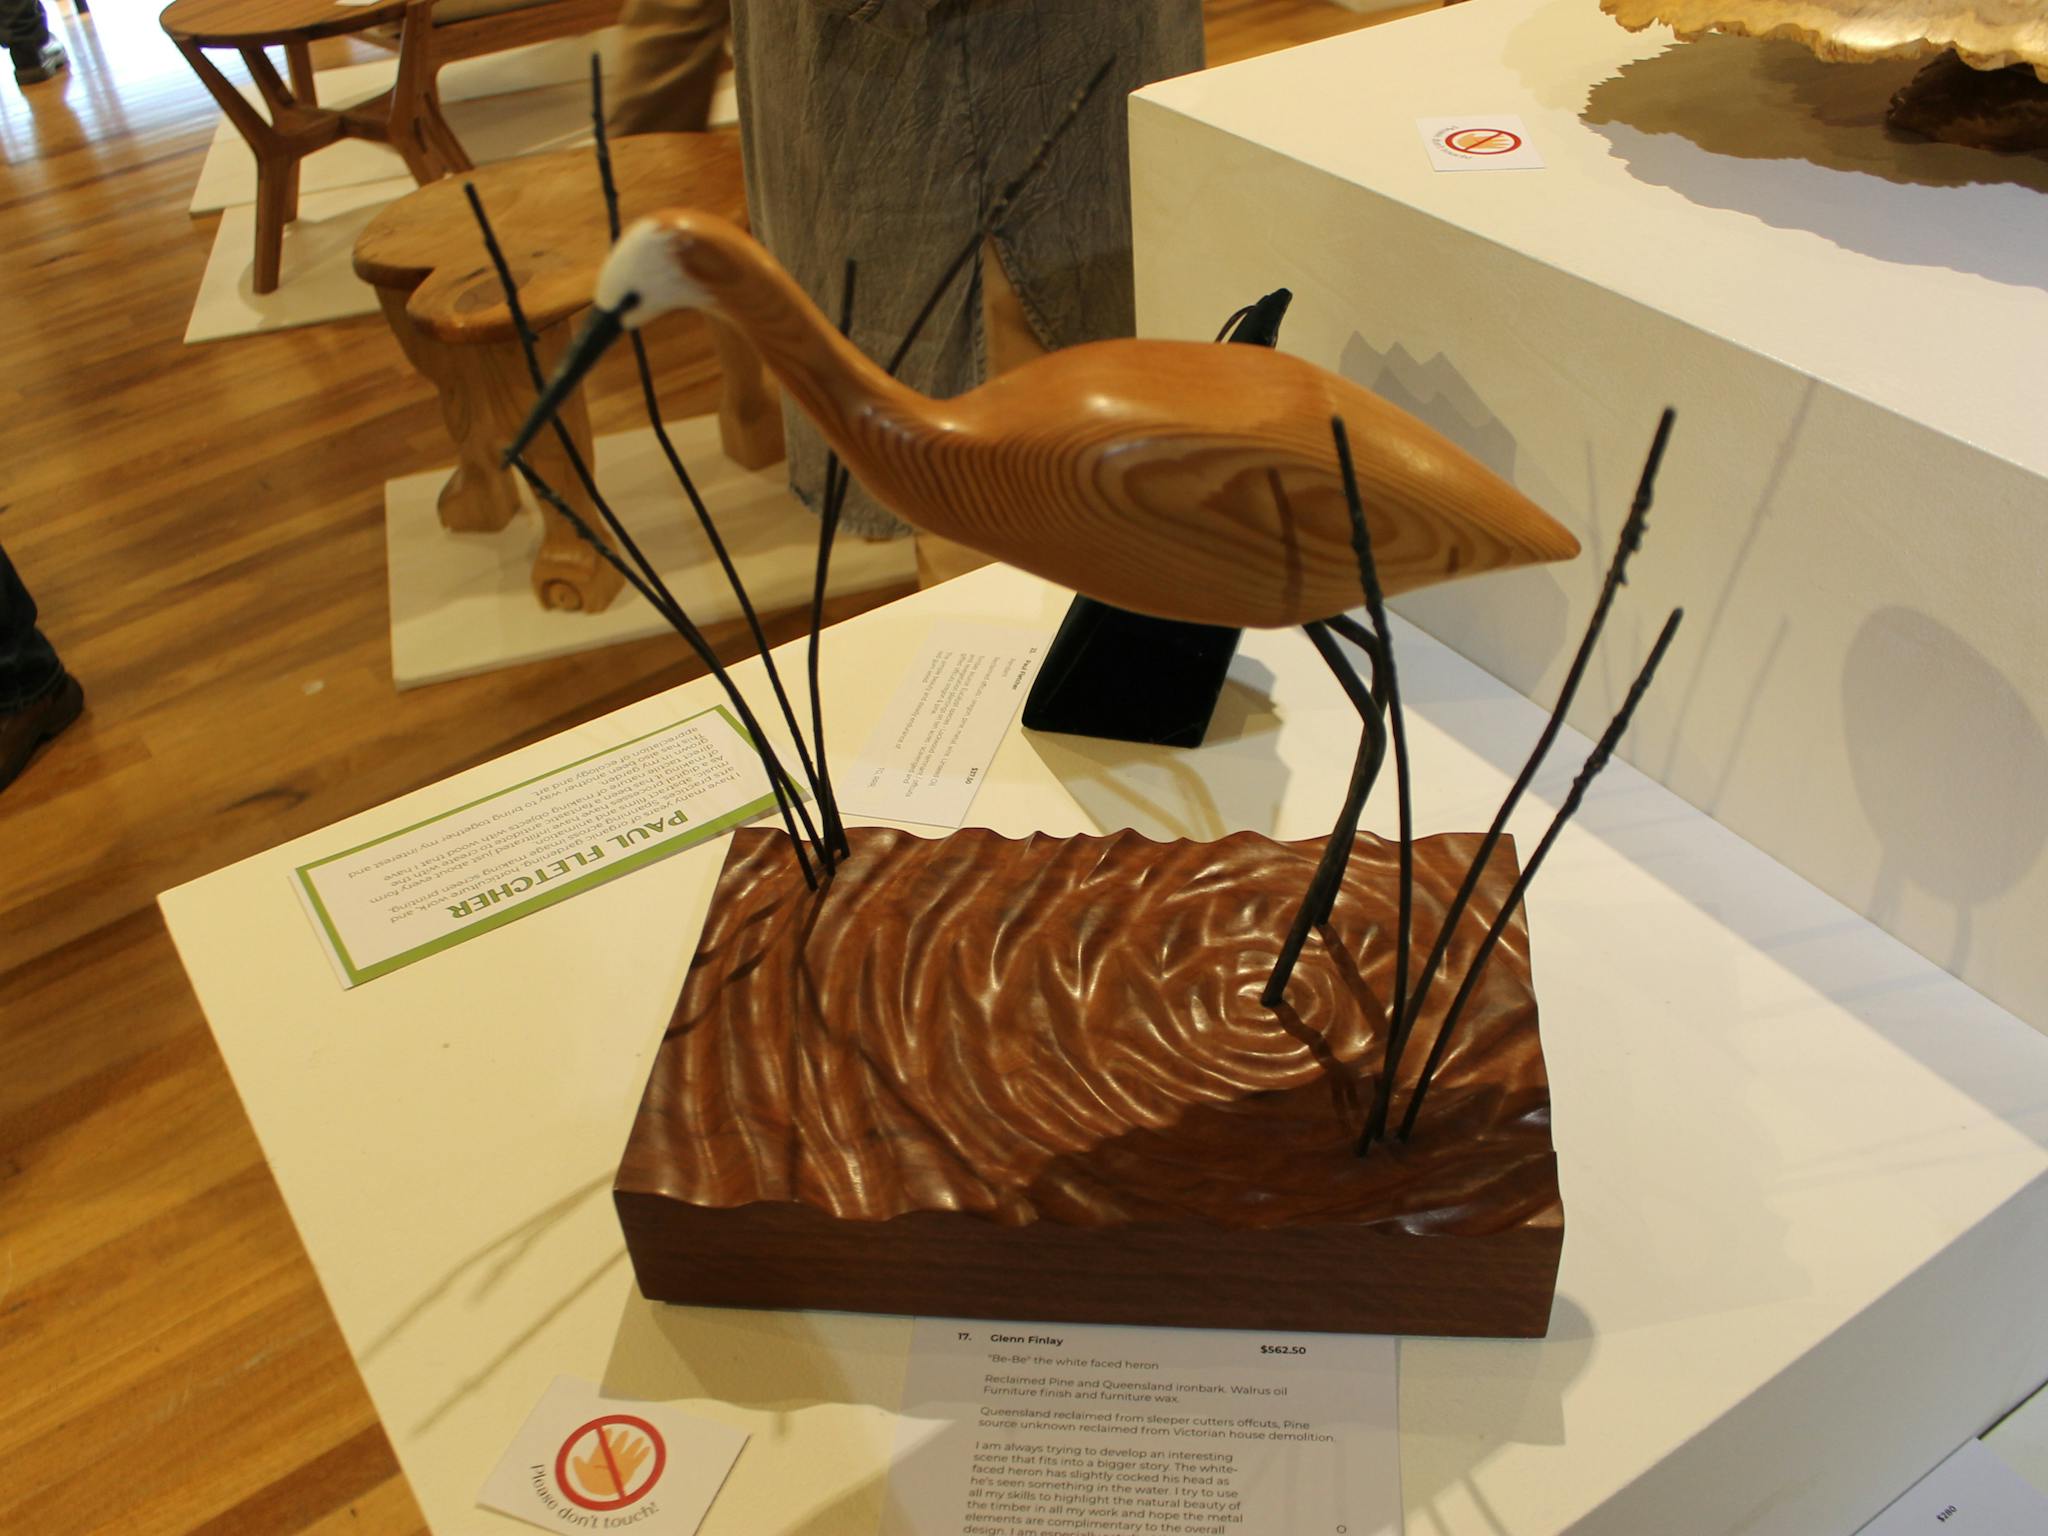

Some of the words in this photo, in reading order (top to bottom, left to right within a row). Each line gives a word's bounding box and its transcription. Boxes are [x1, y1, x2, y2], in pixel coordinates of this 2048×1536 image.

[606, 809, 689, 852] PAUL
[446, 844, 605, 920] FLETCHER
[989, 1334, 1024, 1343] Glenn
[1027, 1335, 1063, 1346] Finlay
[1260, 1344, 1306, 1354] $562.50
[987, 1354, 1030, 1364] "Be-Be"
[1033, 1356, 1052, 1365] the
[1055, 1357, 1087, 1366] white
[1090, 1358, 1122, 1367] faced
[1124, 1360, 1158, 1369] heron
[983, 1386, 1036, 1396] Furniture
[1039, 1389, 1071, 1398] finish
[1074, 1391, 1097, 1399] and
[1100, 1391, 1151, 1401] furniture
[984, 1374, 1045, 1385] Reclaimed
[1048, 1377, 1074, 1386] Pine
[1077, 1379, 1099, 1387] and
[1102, 1379, 1172, 1390] Queensland
[1230, 1384, 1270, 1394] Walrus
[1273, 1386, 1287, 1395] oil
[979, 1407, 1050, 1418] Queensland
[1053, 1411, 1111, 1421] reclaimed
[1115, 1413, 1143, 1422] from
[1147, 1414, 1189, 1425] sleeper
[1192, 1416, 1233, 1426] cutters
[1283, 1420, 1309, 1429] Pine
[1020, 1421, 1075, 1431] unknown
[1079, 1424, 1137, 1433] reclaimed
[1140, 1425, 1169, 1435] from
[1173, 1427, 1225, 1437] Victorian
[1229, 1429, 1264, 1439] house
[1004, 1443, 1043, 1454] always
[1046, 1445, 1081, 1456] trying
[1099, 1447, 1146, 1459] develop
[1168, 1450, 1232, 1462] interesting
[1011, 1455, 1034, 1464] that
[1038, 1456, 1057, 1465] fits
[1061, 1457, 1083, 1466] into
[1097, 1459, 1135, 1469] bigger
[1174, 1462, 1196, 1471] The
[1199, 1463, 1237, 1472] white-
[971, 1465, 1004, 1474] faced
[1007, 1466, 1042, 1476] heron
[1046, 1468, 1066, 1477] has
[1070, 1469, 1112, 1481] slightly
[1116, 1472, 1159, 1481] cocked
[1162, 1473, 1179, 1482] his
[1183, 1474, 1212, 1484] head
[531, 1464, 558, 1510] Please
[558, 1507, 599, 1528] don't
[604, 1501, 660, 1528] touch!
[970, 1477, 993, 1486] he's
[1028, 1481, 1093, 1492] something
[1111, 1483, 1131, 1492] the
[1181, 1486, 1197, 1497] try
[968, 1489, 982, 1498] all
[1007, 1491, 1035, 1500] skills
[1054, 1493, 1108, 1505] highlight
[1112, 1495, 1133, 1504] the
[1136, 1497, 1179, 1507] natural
[1183, 1498, 1225, 1511] beauty
[966, 1501, 986, 1511] the
[989, 1502, 1030, 1513] timber
[1047, 1505, 1062, 1514] all
[1088, 1508, 1117, 1517] work
[1121, 1509, 1145, 1518] and
[1148, 1510, 1179, 1521] hope
[1182, 1511, 1203, 1520] the
[1207, 1513, 1243, 1522] metal
[964, 1513, 1022, 1524] elements
[1047, 1518, 1141, 1531] complimentary
[1160, 1522, 1181, 1531] the
[1184, 1524, 1224, 1533] overall
